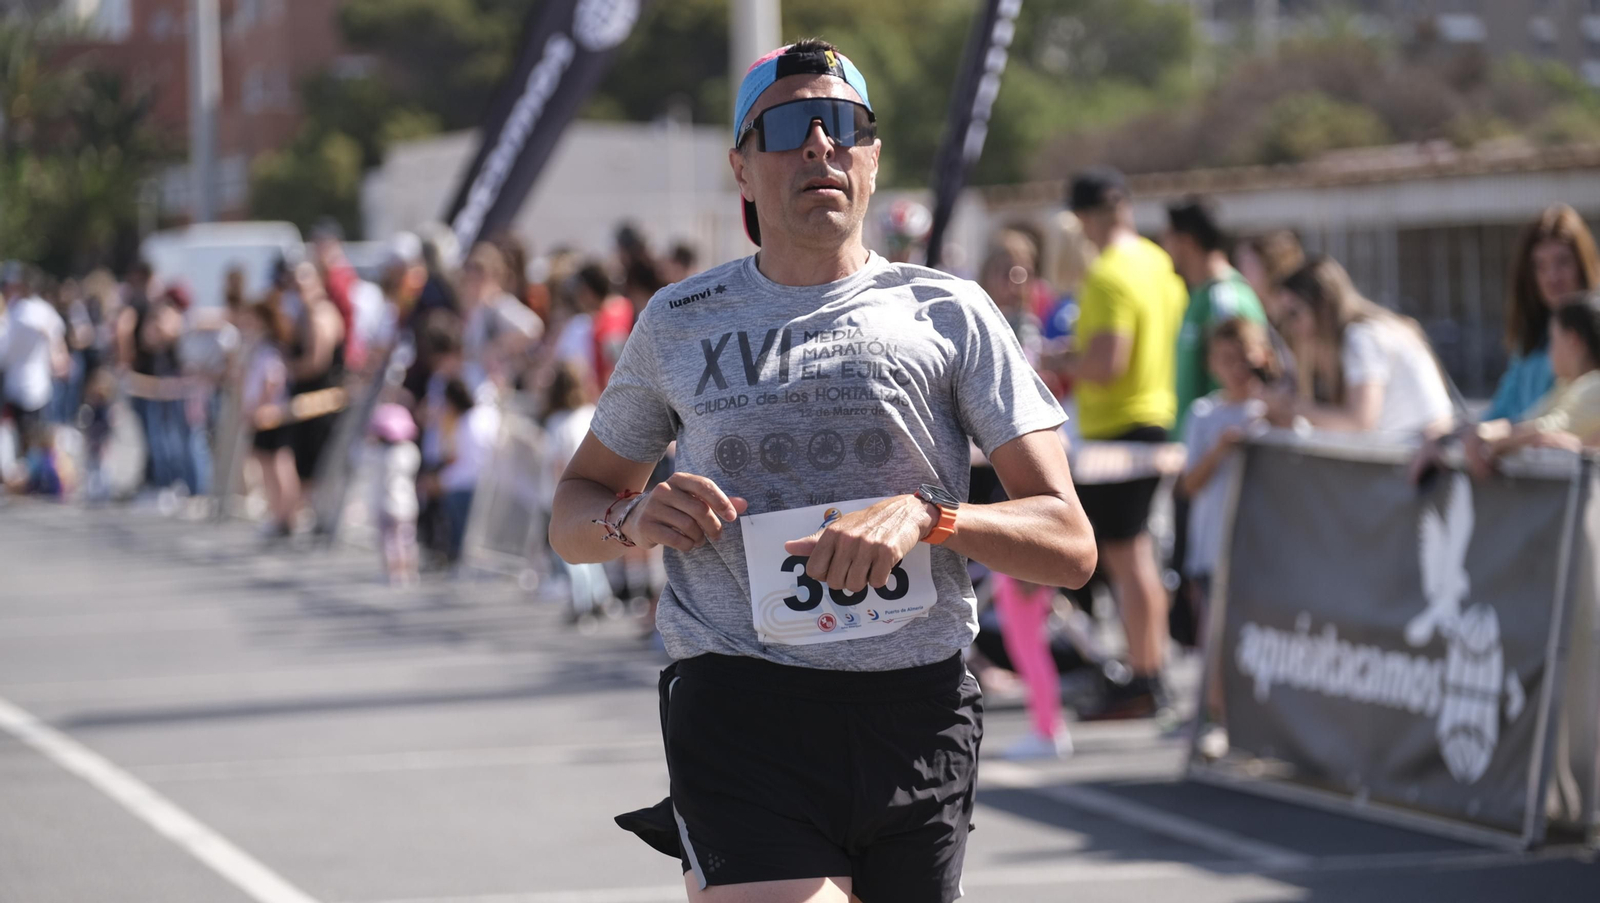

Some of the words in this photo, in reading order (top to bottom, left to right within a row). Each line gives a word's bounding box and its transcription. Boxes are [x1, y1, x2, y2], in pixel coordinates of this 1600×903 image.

[669, 288, 712, 309] luanvi
[804, 327, 864, 344] MEDIA
[803, 338, 898, 361] MARATÓN
[695, 328, 792, 397] XVI
[801, 363, 831, 380] EL
[841, 360, 911, 387] EJIDO
[695, 394, 749, 416] CIUDAD
[756, 392, 778, 406] de
[784, 390, 809, 404] los
[815, 386, 910, 407] HORTALIZAS
[832, 405, 868, 416] Marzo
[870, 405, 886, 416] de
